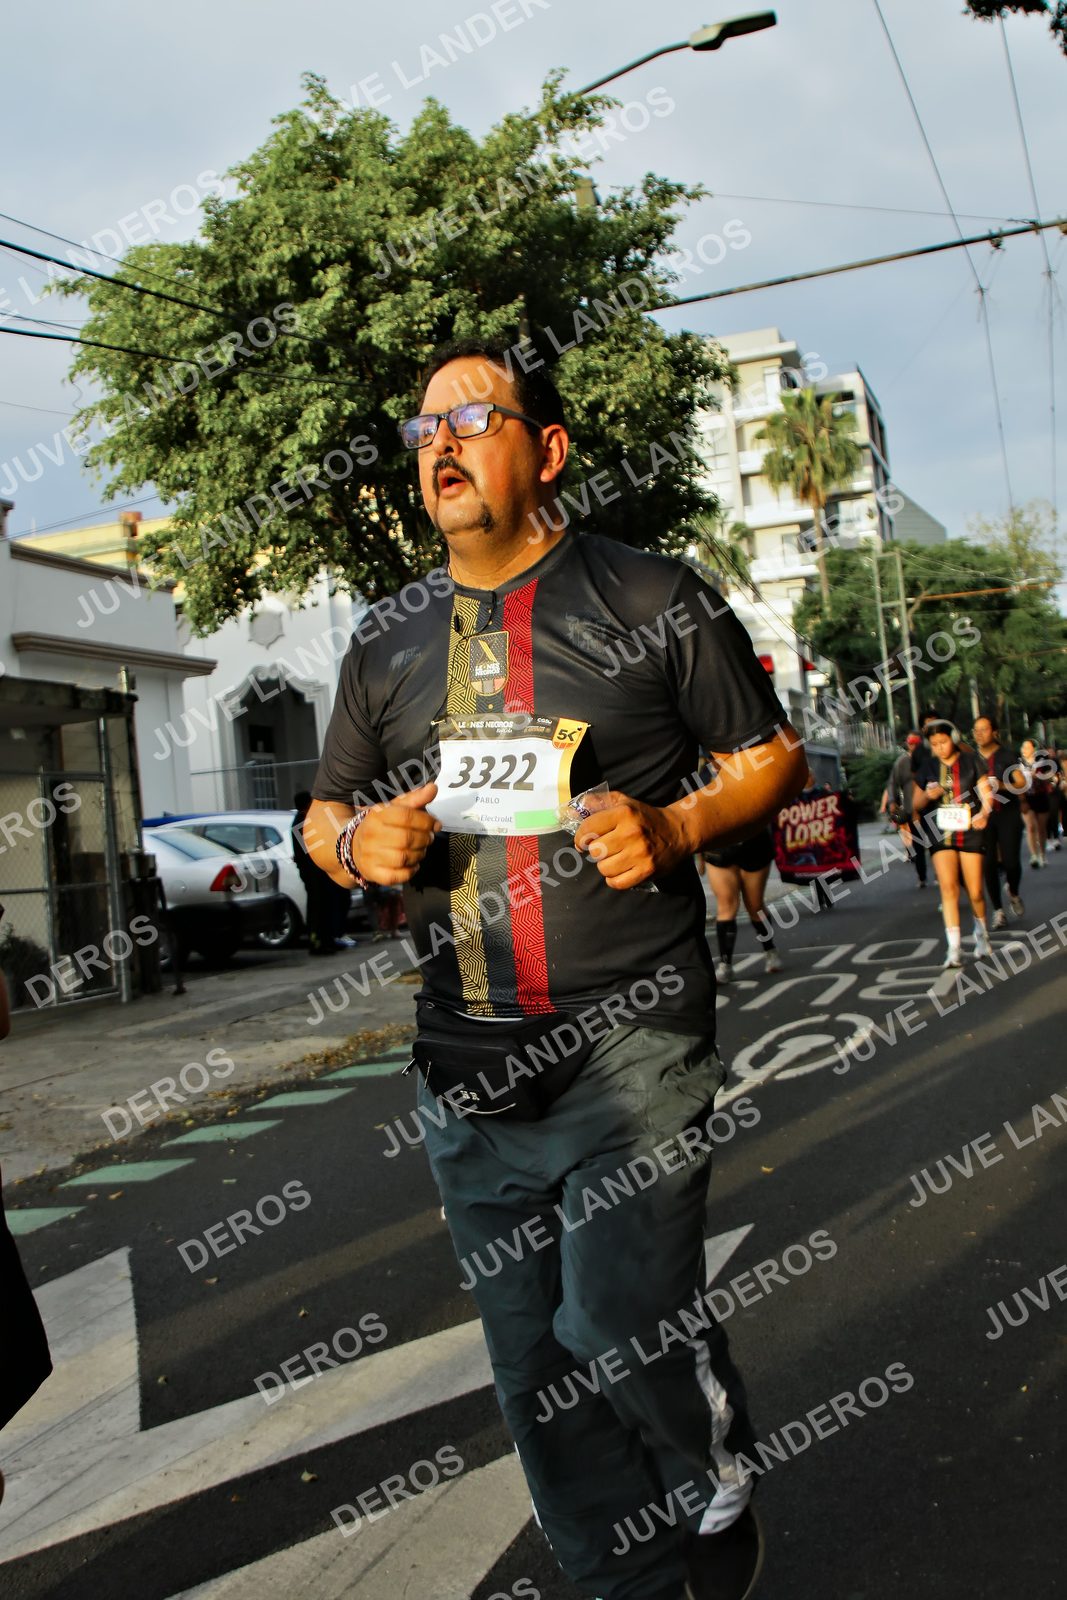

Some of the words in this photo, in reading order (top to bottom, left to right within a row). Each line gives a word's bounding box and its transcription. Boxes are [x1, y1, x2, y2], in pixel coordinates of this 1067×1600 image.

[556, 729, 577, 741] 5K
[448, 752, 537, 791] 3322
[475, 796, 500, 804] PABLO
[778, 795, 841, 829] POWER
[785, 816, 835, 850] LORE
